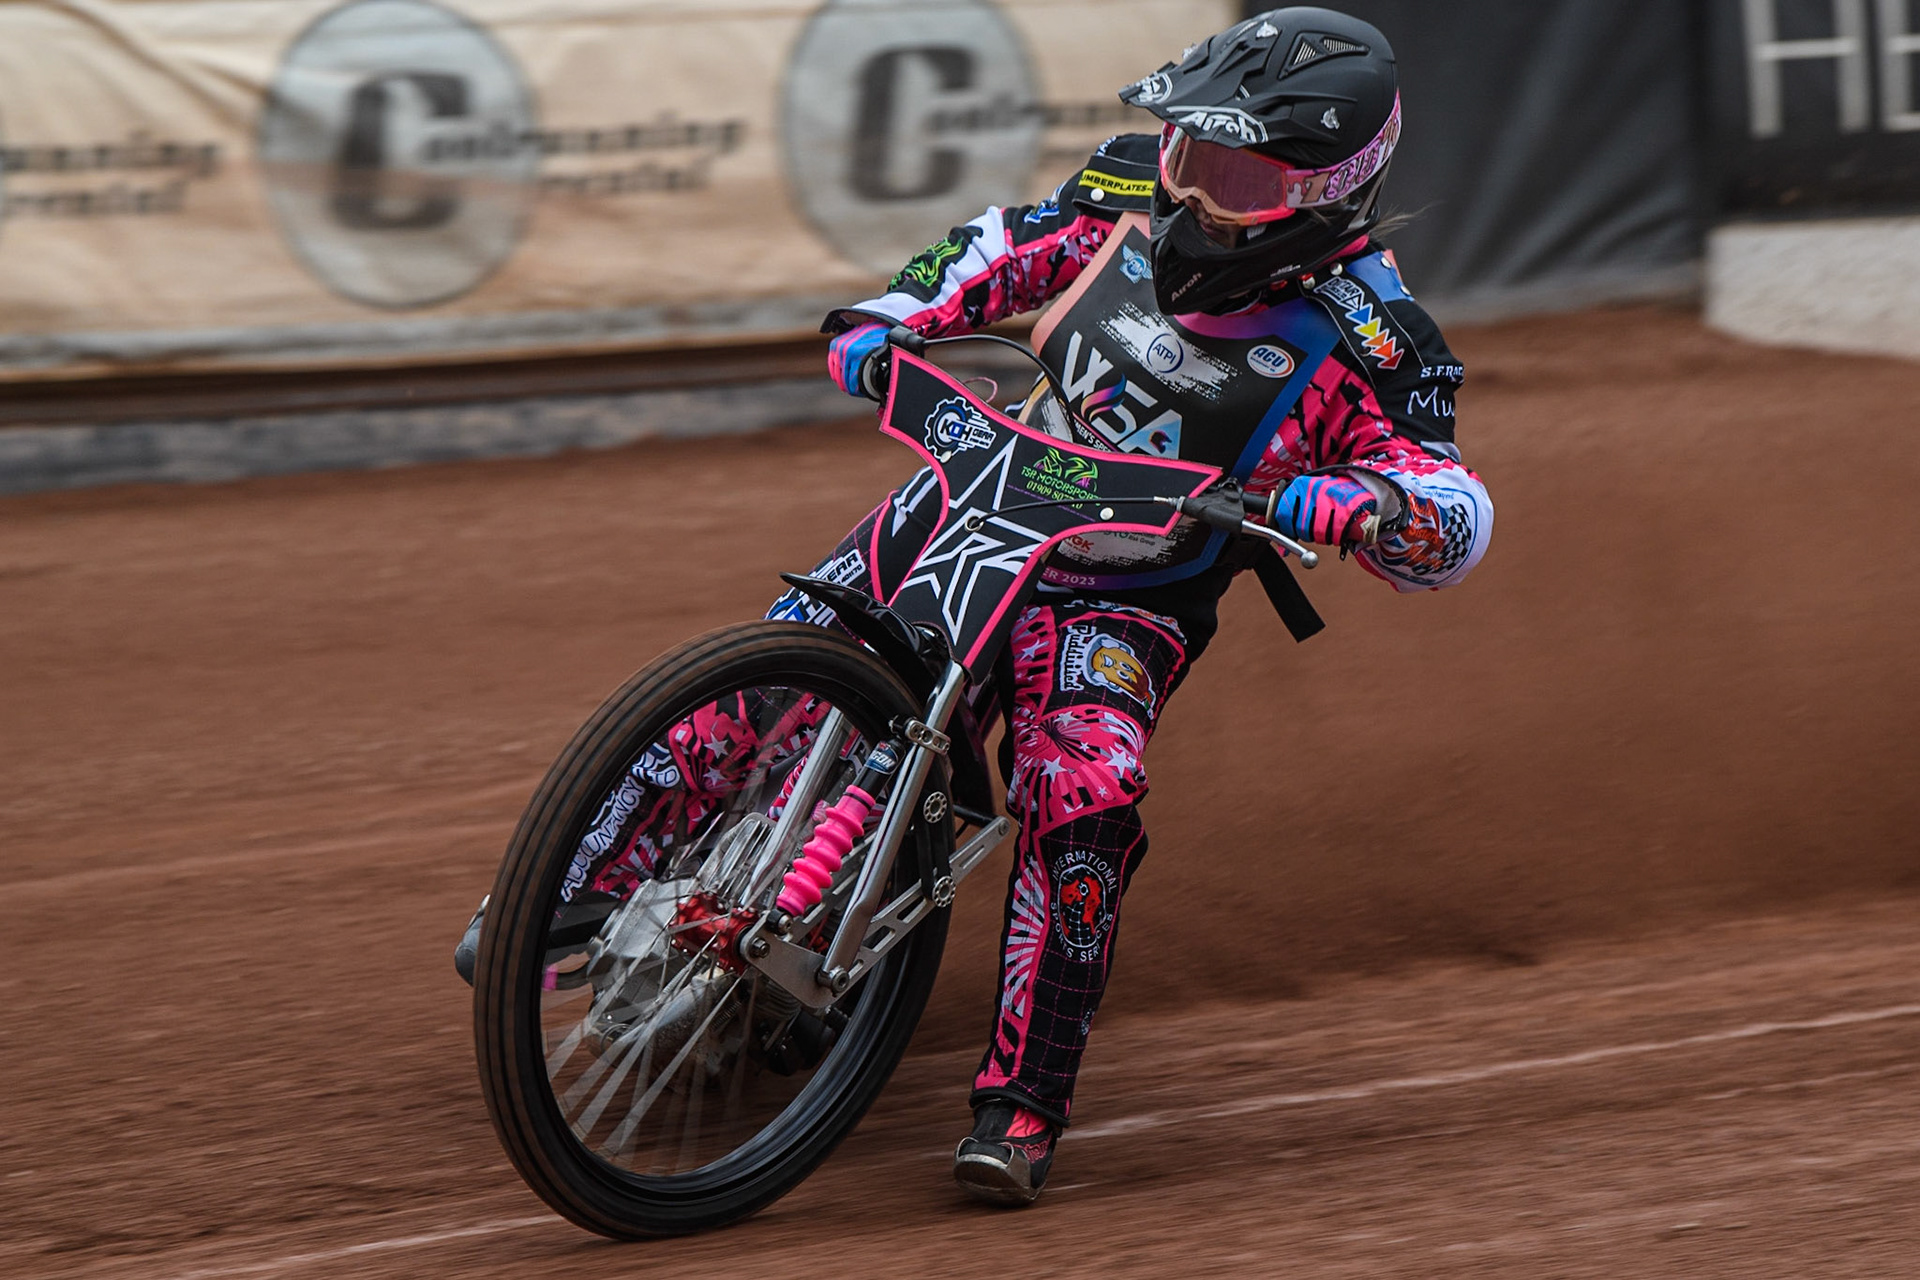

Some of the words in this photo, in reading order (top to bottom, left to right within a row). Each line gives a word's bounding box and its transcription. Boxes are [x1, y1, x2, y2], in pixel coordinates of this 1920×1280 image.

[1153, 340, 1177, 364] ATPI
[1253, 347, 1286, 368] ACU
[1021, 466, 1037, 479] TSR
[1026, 480, 1052, 496] 01909
[1063, 535, 1095, 551] GK
[824, 552, 860, 580] EAR
[1061, 573, 1097, 586] 2023
[1052, 850, 1118, 893] INTERNATIONAL
